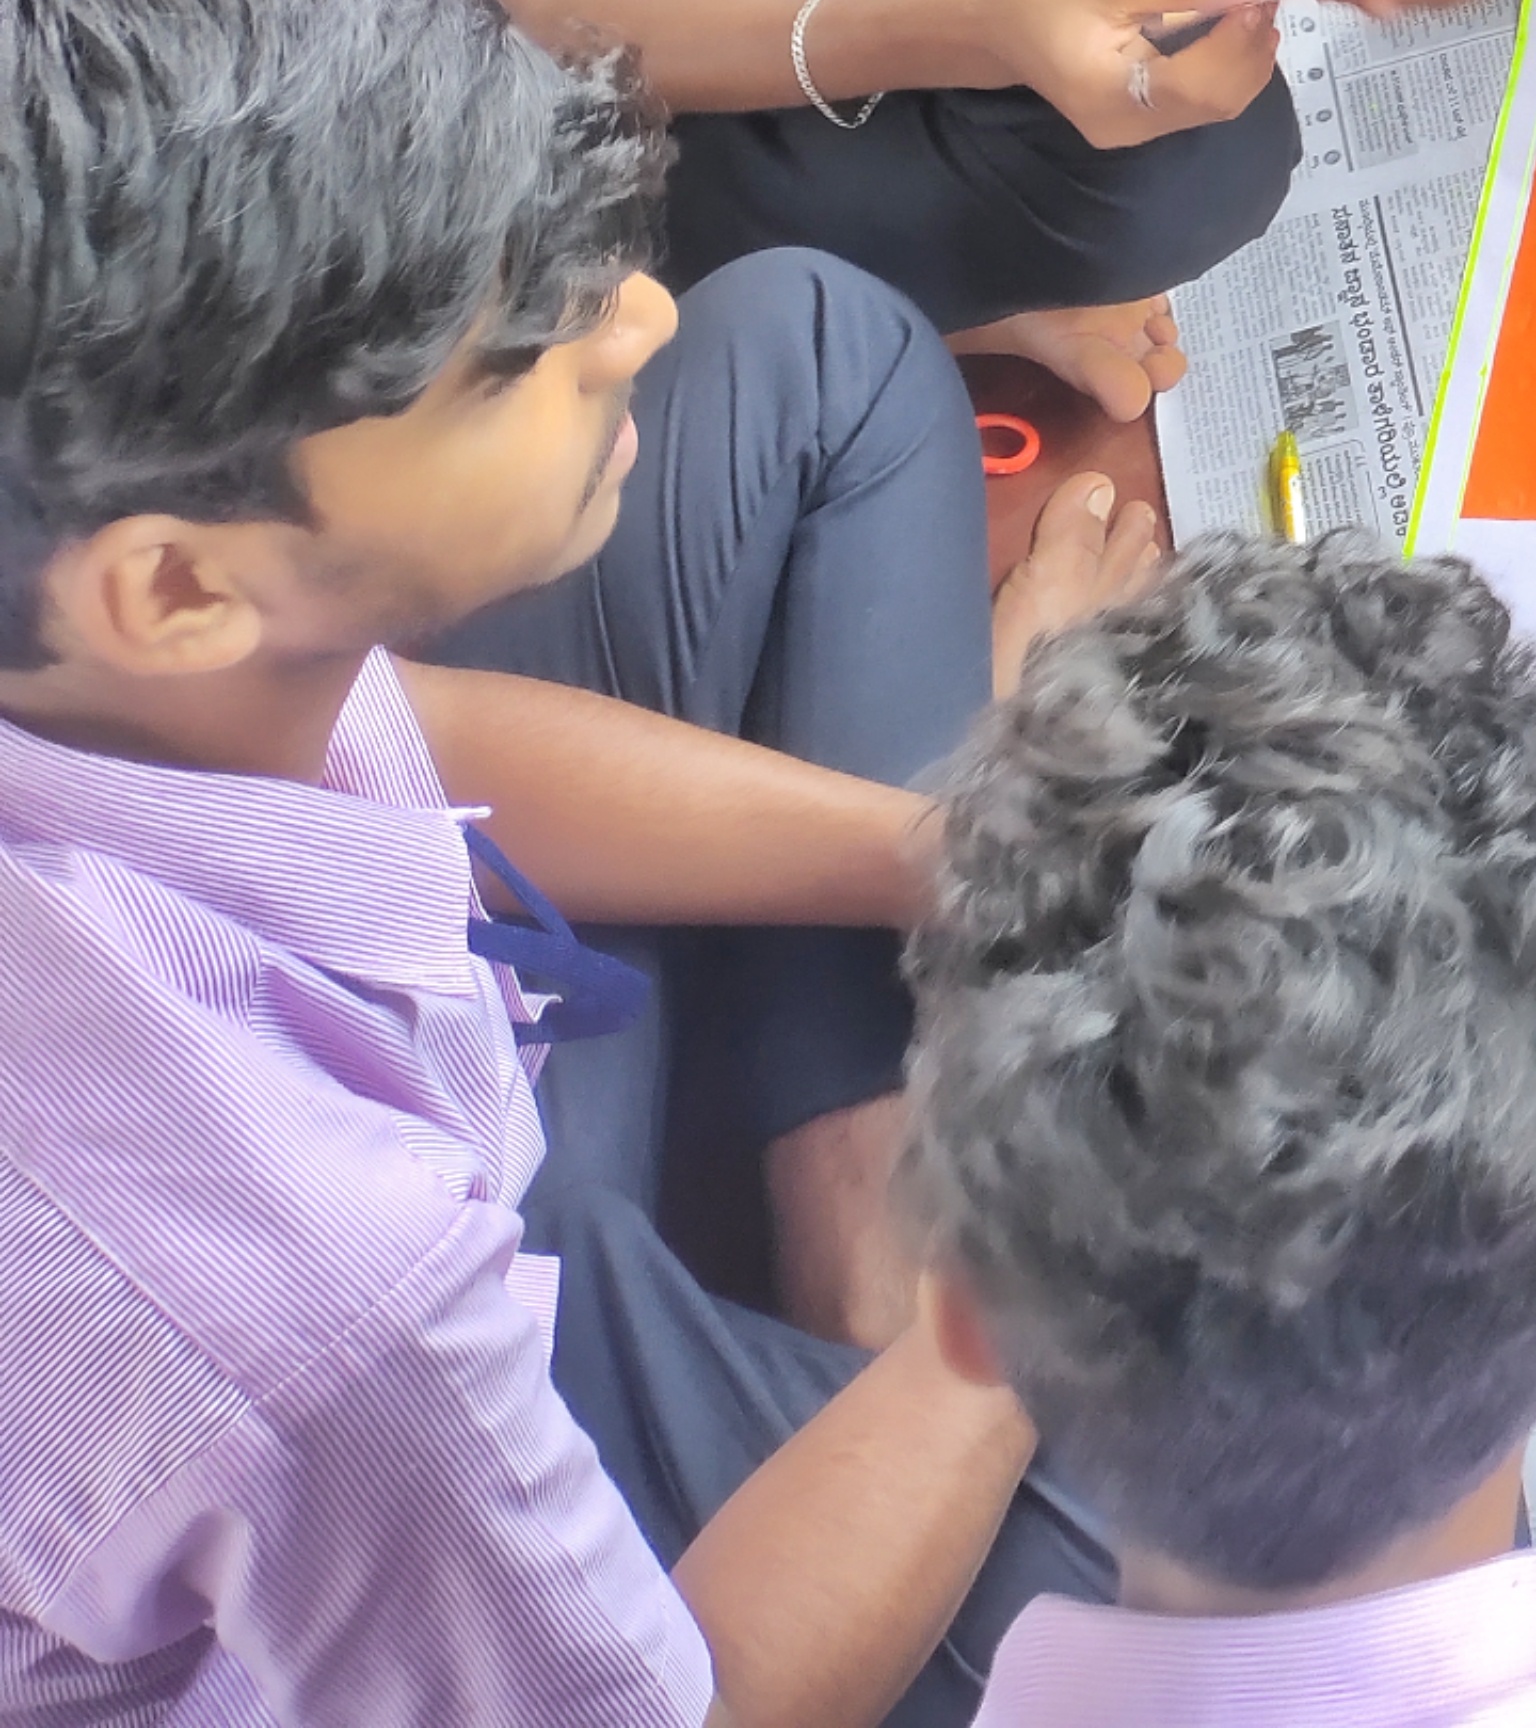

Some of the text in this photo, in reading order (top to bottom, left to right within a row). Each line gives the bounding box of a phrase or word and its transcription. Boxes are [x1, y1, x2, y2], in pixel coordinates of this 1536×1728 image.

[1332, 205, 1360, 264] ಸನಾತನ
[1350, 311, 1385, 378] ಭಂಡಾರ
[1368, 383, 1407, 499] ತಾಳೆಗರಿಯಲ್ಲಿ
